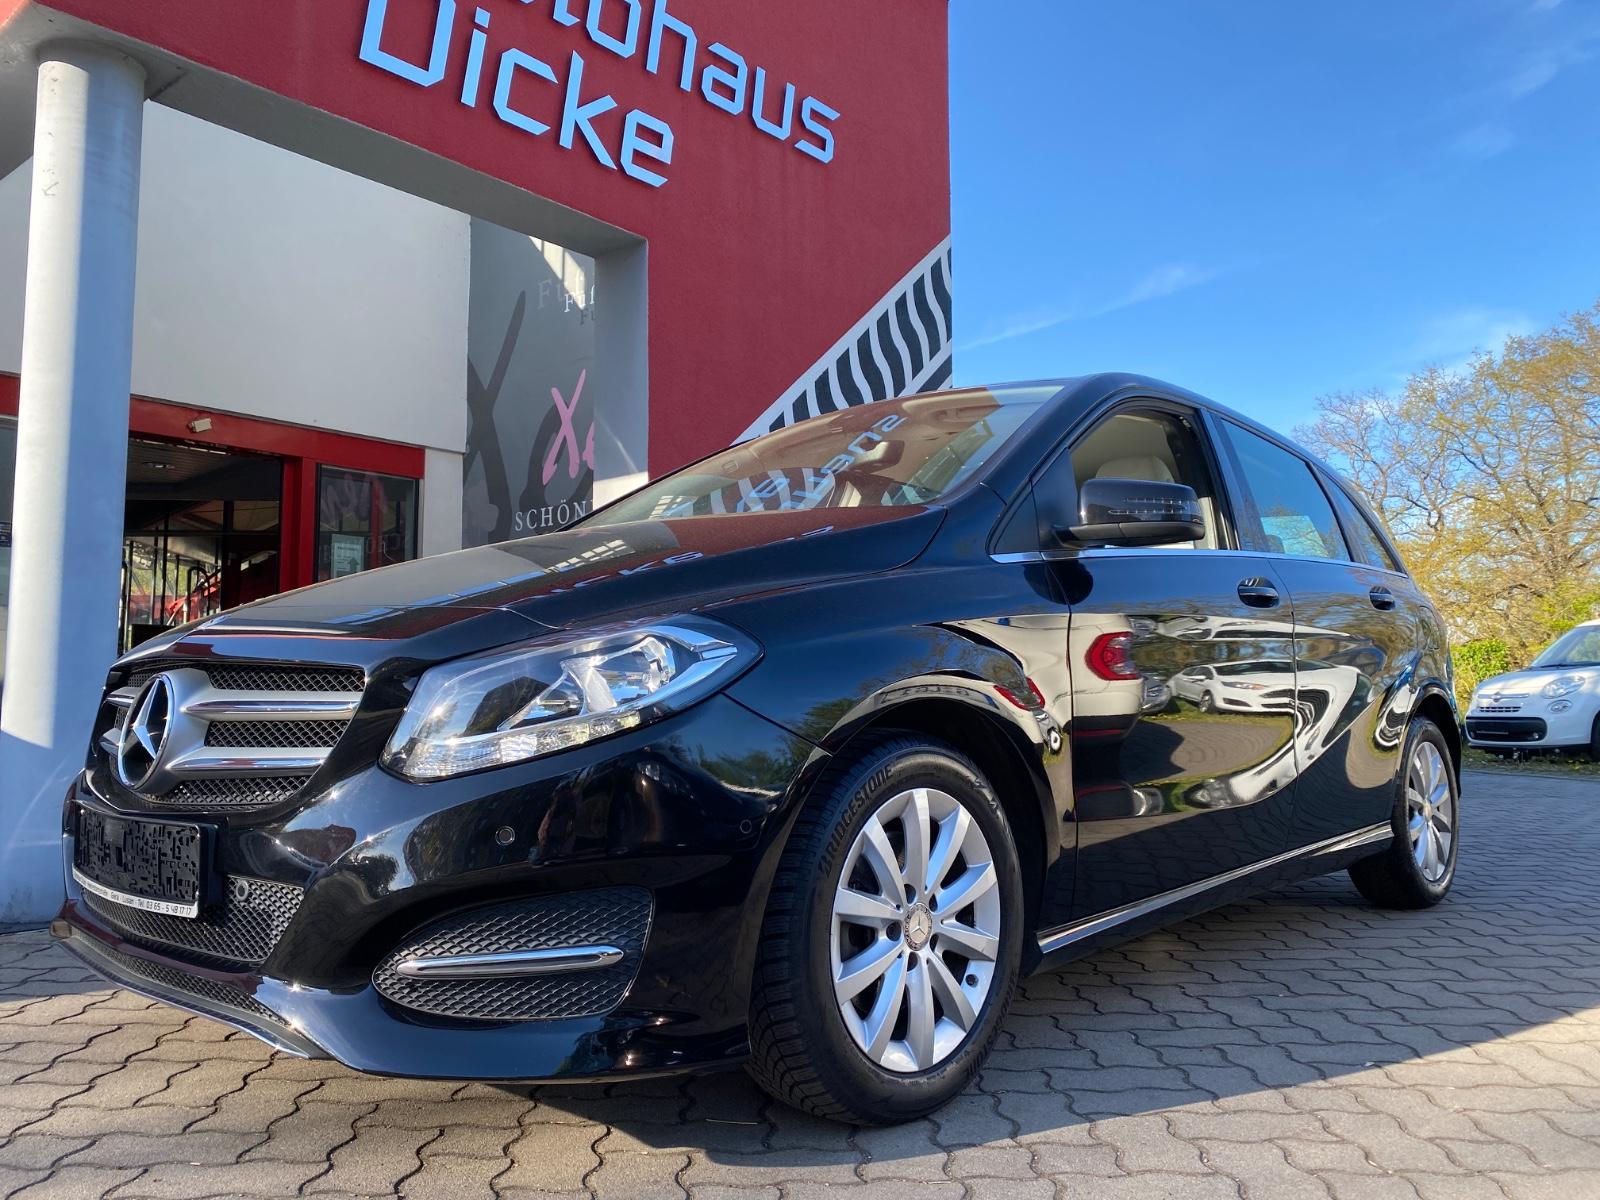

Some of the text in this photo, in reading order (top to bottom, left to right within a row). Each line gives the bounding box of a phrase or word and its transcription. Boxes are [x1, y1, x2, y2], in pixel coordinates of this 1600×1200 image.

[358, 0, 675, 188] Dicke
[519, 0, 841, 164] ohaus
[515, 499, 592, 532] SCHÖN
[819, 764, 894, 878] BRIDGESTONE
